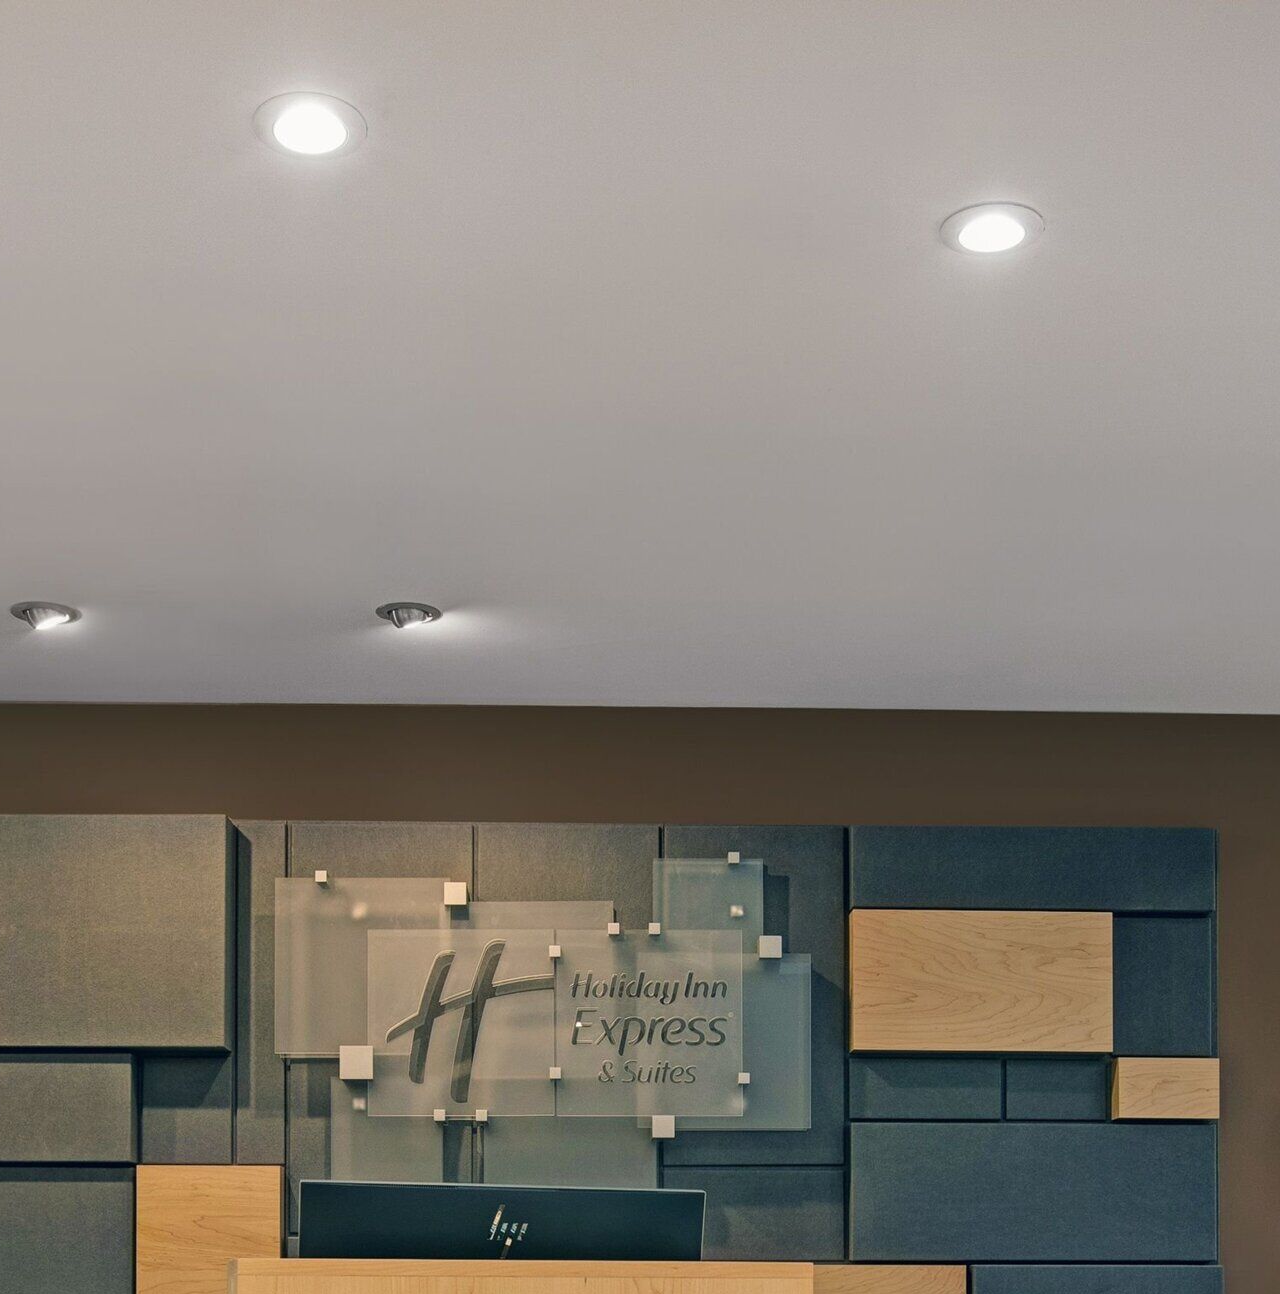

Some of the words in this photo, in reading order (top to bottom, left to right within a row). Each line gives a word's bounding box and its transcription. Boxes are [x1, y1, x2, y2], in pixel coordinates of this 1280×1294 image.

[570, 969, 680, 1005] Holiday
[683, 969, 728, 998] Inn
[570, 1005, 728, 1056] Express
[597, 1060, 615, 1084] &
[620, 1059, 698, 1085] Suites
